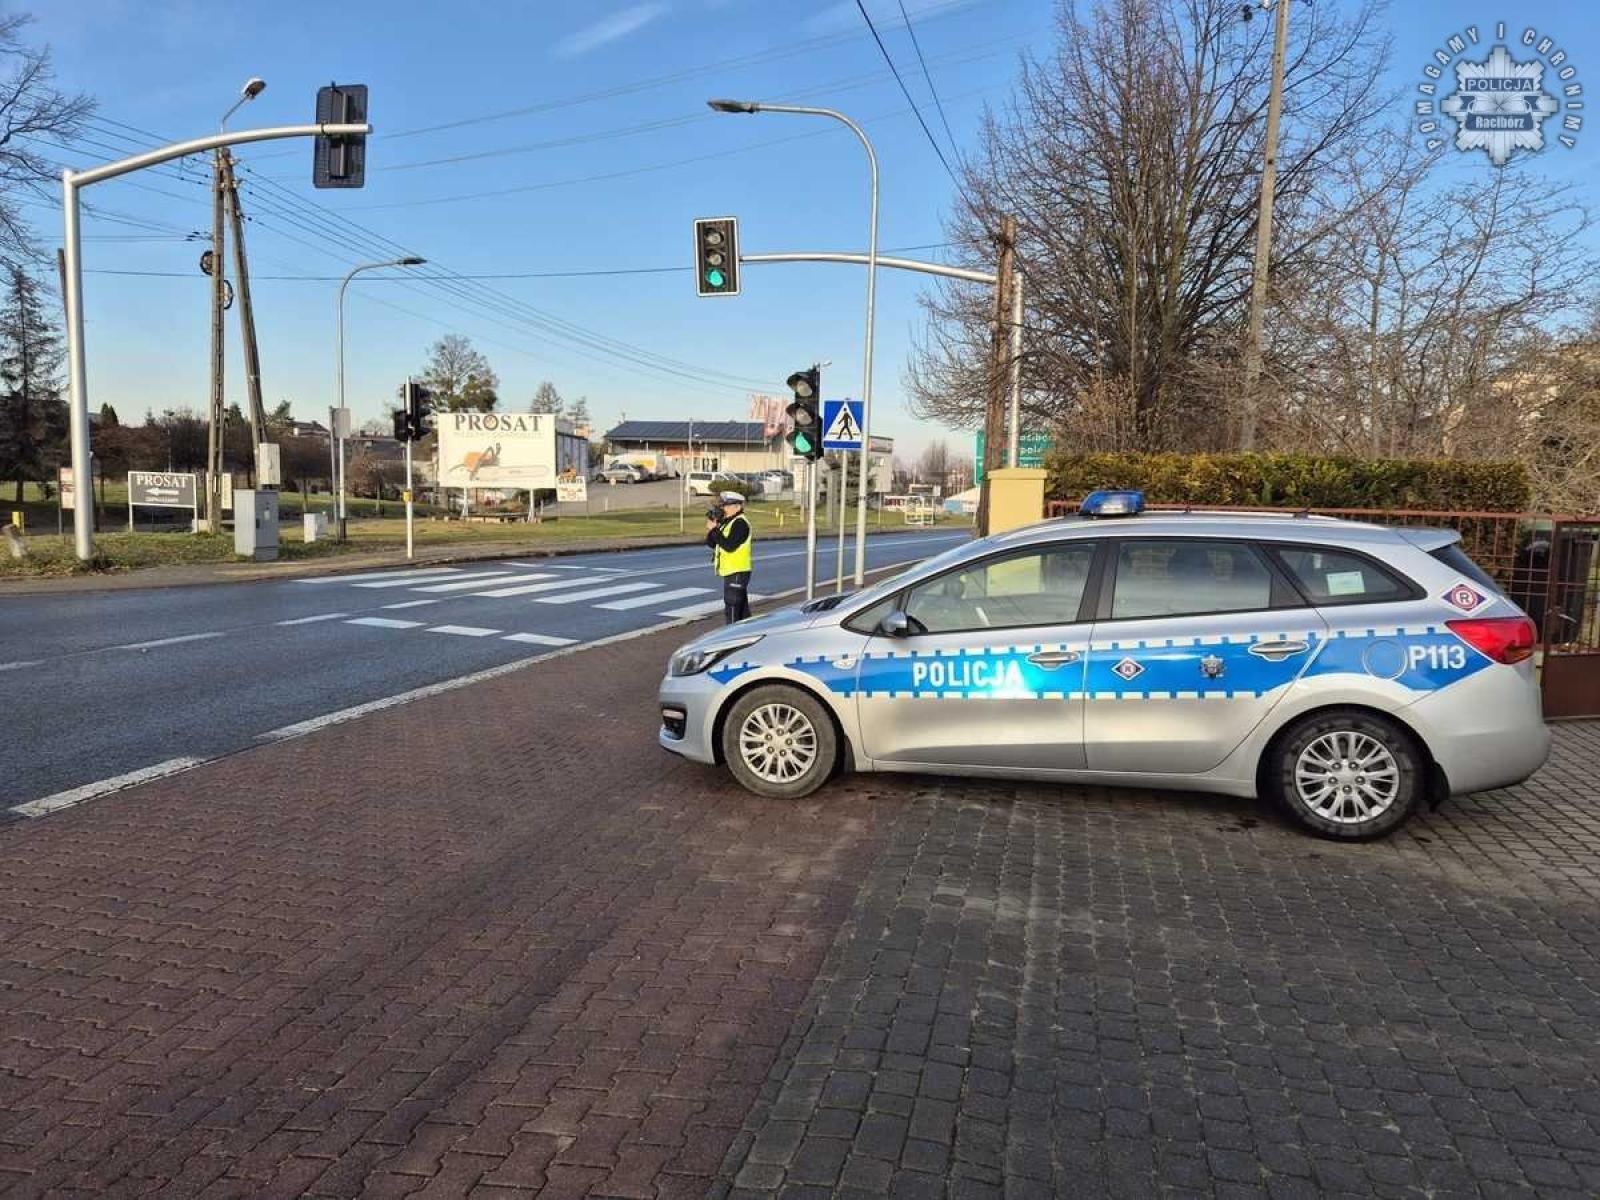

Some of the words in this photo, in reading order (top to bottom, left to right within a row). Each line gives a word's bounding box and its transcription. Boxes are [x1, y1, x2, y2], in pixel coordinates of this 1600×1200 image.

[454, 413, 543, 432] PROSAT
[136, 475, 189, 489] PROSAT
[1408, 645, 1467, 669] P113
[913, 659, 1024, 688] POLICJA
